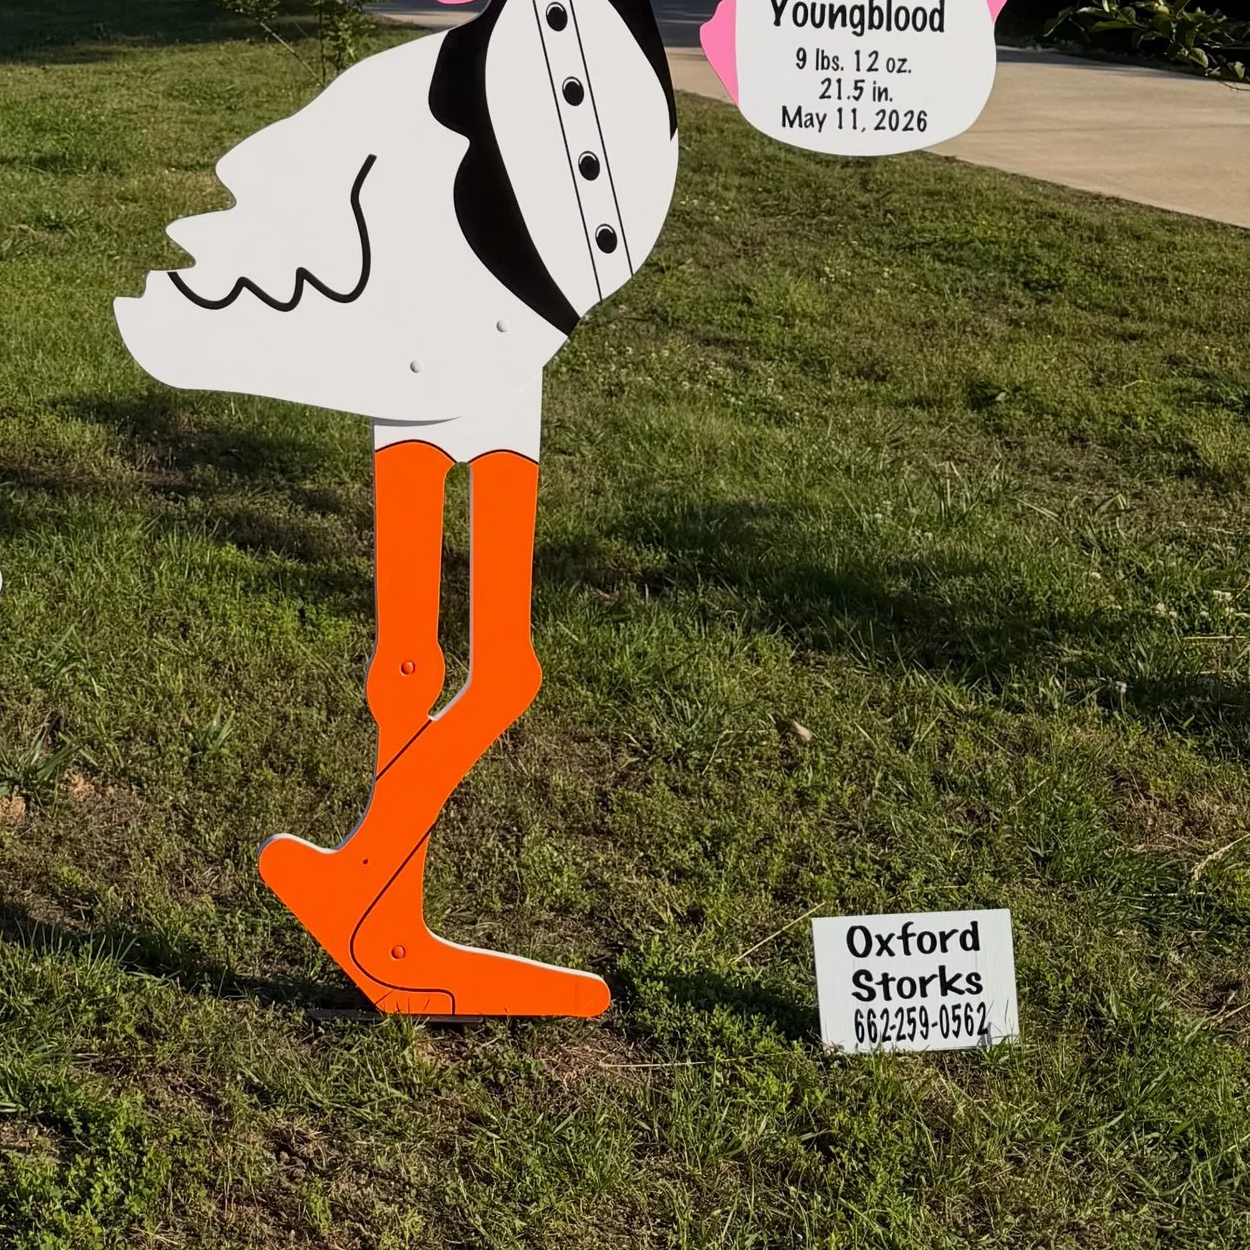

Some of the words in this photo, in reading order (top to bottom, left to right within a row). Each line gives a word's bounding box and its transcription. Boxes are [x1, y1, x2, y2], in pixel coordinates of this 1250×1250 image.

[796, 48, 807, 69] 9
[816, 48, 844, 71] lbs.
[855, 50, 879, 72] 12
[886, 58, 912, 74] oz.
[819, 78, 865, 100] 21.5
[872, 81, 893, 102] in.
[782, 105, 827, 133] May
[837, 107, 866, 133] 11,
[874, 109, 927, 132] 2026
[847, 921, 980, 958] Oxford
[852, 965, 983, 1002] Storks
